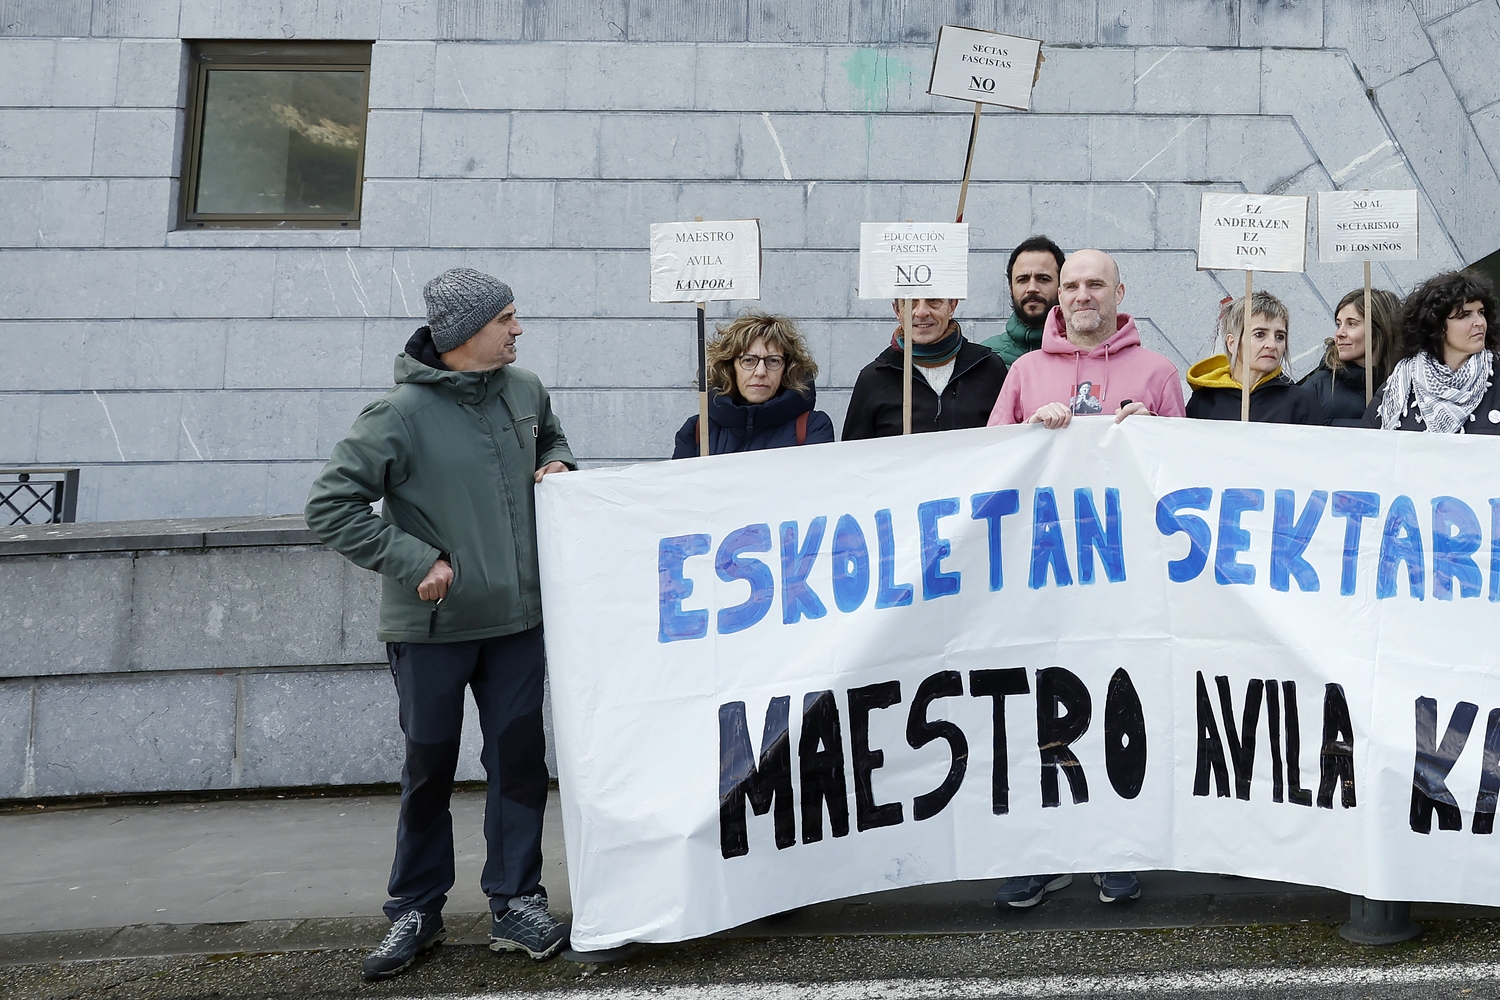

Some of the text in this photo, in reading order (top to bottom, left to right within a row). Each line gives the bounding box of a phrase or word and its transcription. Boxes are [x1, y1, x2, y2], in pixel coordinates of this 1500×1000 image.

[972, 43, 1009, 57] SECTAS
[961, 54, 1012, 69] FASCISTAS
[969, 75, 996, 92] NO
[1246, 204, 1263, 215] EZ
[1352, 200, 1383, 209] NO AL
[1214, 217, 1290, 230] ANDERAZEN
[1336, 221, 1400, 231] SECTARISMO
[675, 231, 734, 243] MAESTRO
[1243, 232, 1259, 242] EZ
[890, 244, 938, 253] FASCISTA
[1236, 246, 1268, 257] INON
[1335, 241, 1402, 252] DE LOS NIÑOS
[686, 255, 723, 266] AVILA
[894, 264, 932, 284] NO
[675, 279, 734, 290] KANPORA
[657, 486, 1127, 645] ESKOLETAN
[717, 665, 1148, 861] MAESTRO
[1193, 670, 1357, 810] AVILA
